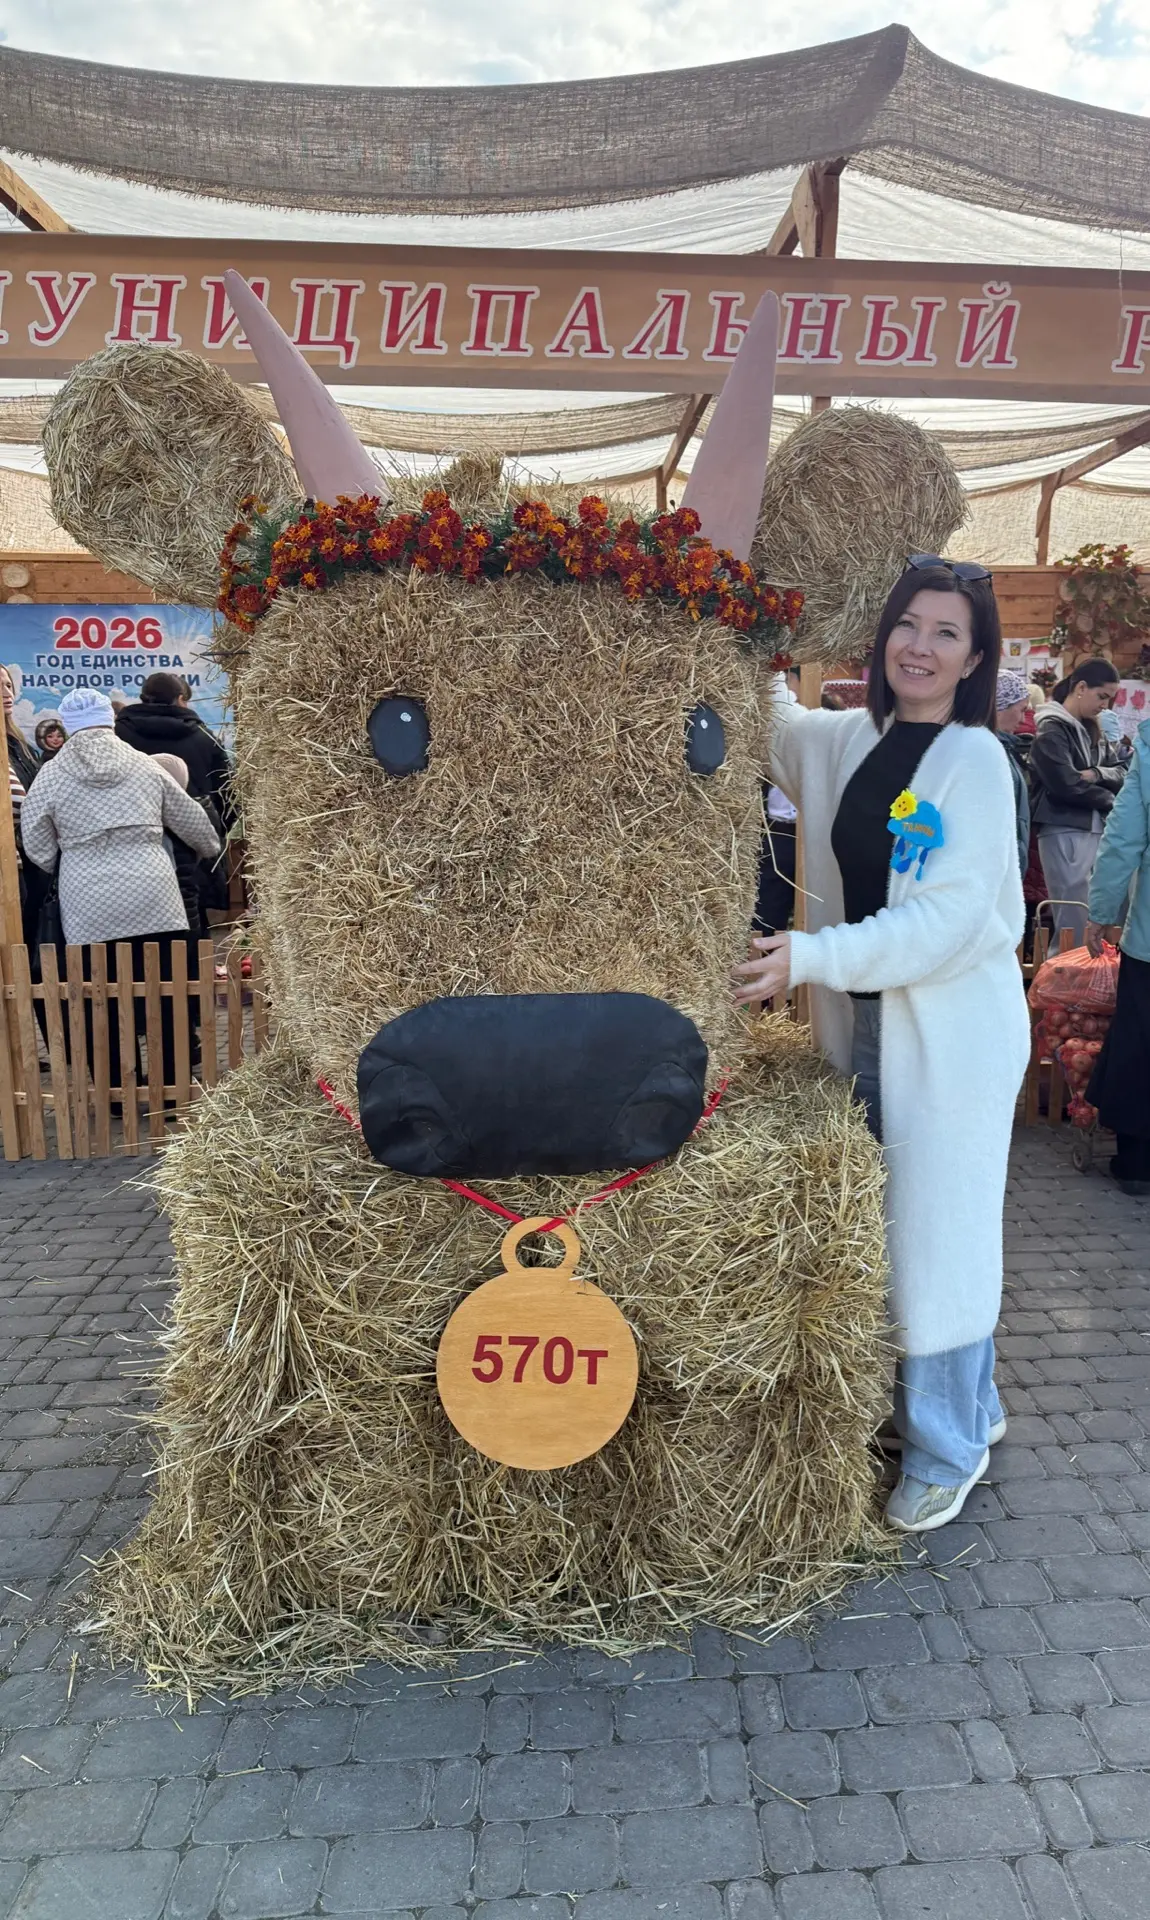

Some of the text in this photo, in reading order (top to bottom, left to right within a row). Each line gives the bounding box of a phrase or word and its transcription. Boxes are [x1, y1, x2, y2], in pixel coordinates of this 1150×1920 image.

[0, 271, 1020, 369] УНИЦИПАЛЬНЫЙ
[54, 617, 163, 649] 2026
[36, 655, 184, 669] ГОД ЕДИНСТВА
[22, 674, 201, 688] НАРОДОВ РОИ
